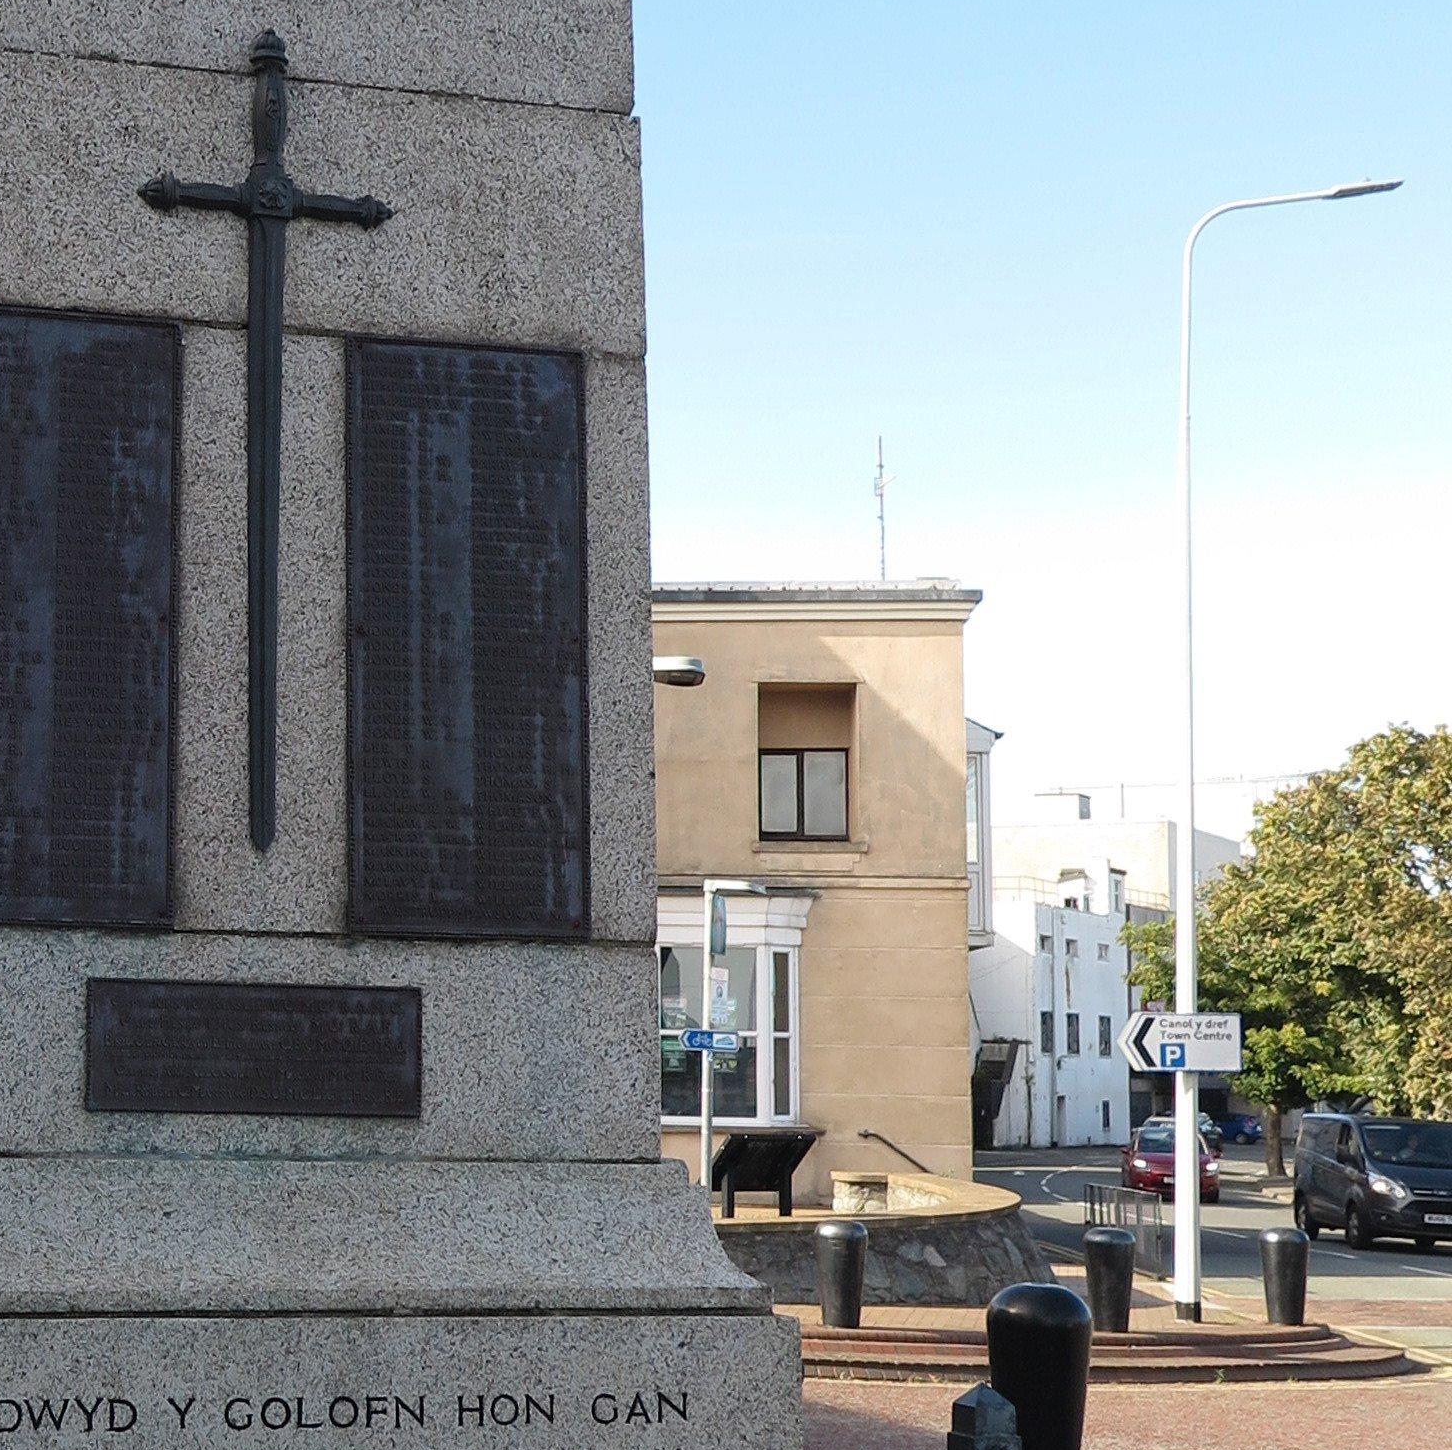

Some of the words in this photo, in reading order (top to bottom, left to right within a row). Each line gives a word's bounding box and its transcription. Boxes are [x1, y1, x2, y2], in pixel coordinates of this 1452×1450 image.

[1159, 1018, 1193, 1029] Canol
[1195, 1021, 1203, 1030] y
[1205, 1019, 1229, 1029] dref
[1159, 1030, 1190, 1040] Town
[1193, 1030, 1233, 1041] Centre
[1165, 1045, 1181, 1067] P
[167, 1396, 197, 1430] Y
[224, 1394, 427, 1431] GOLOFN
[456, 1393, 555, 1428] HON
[590, 1391, 689, 1425] GAN
